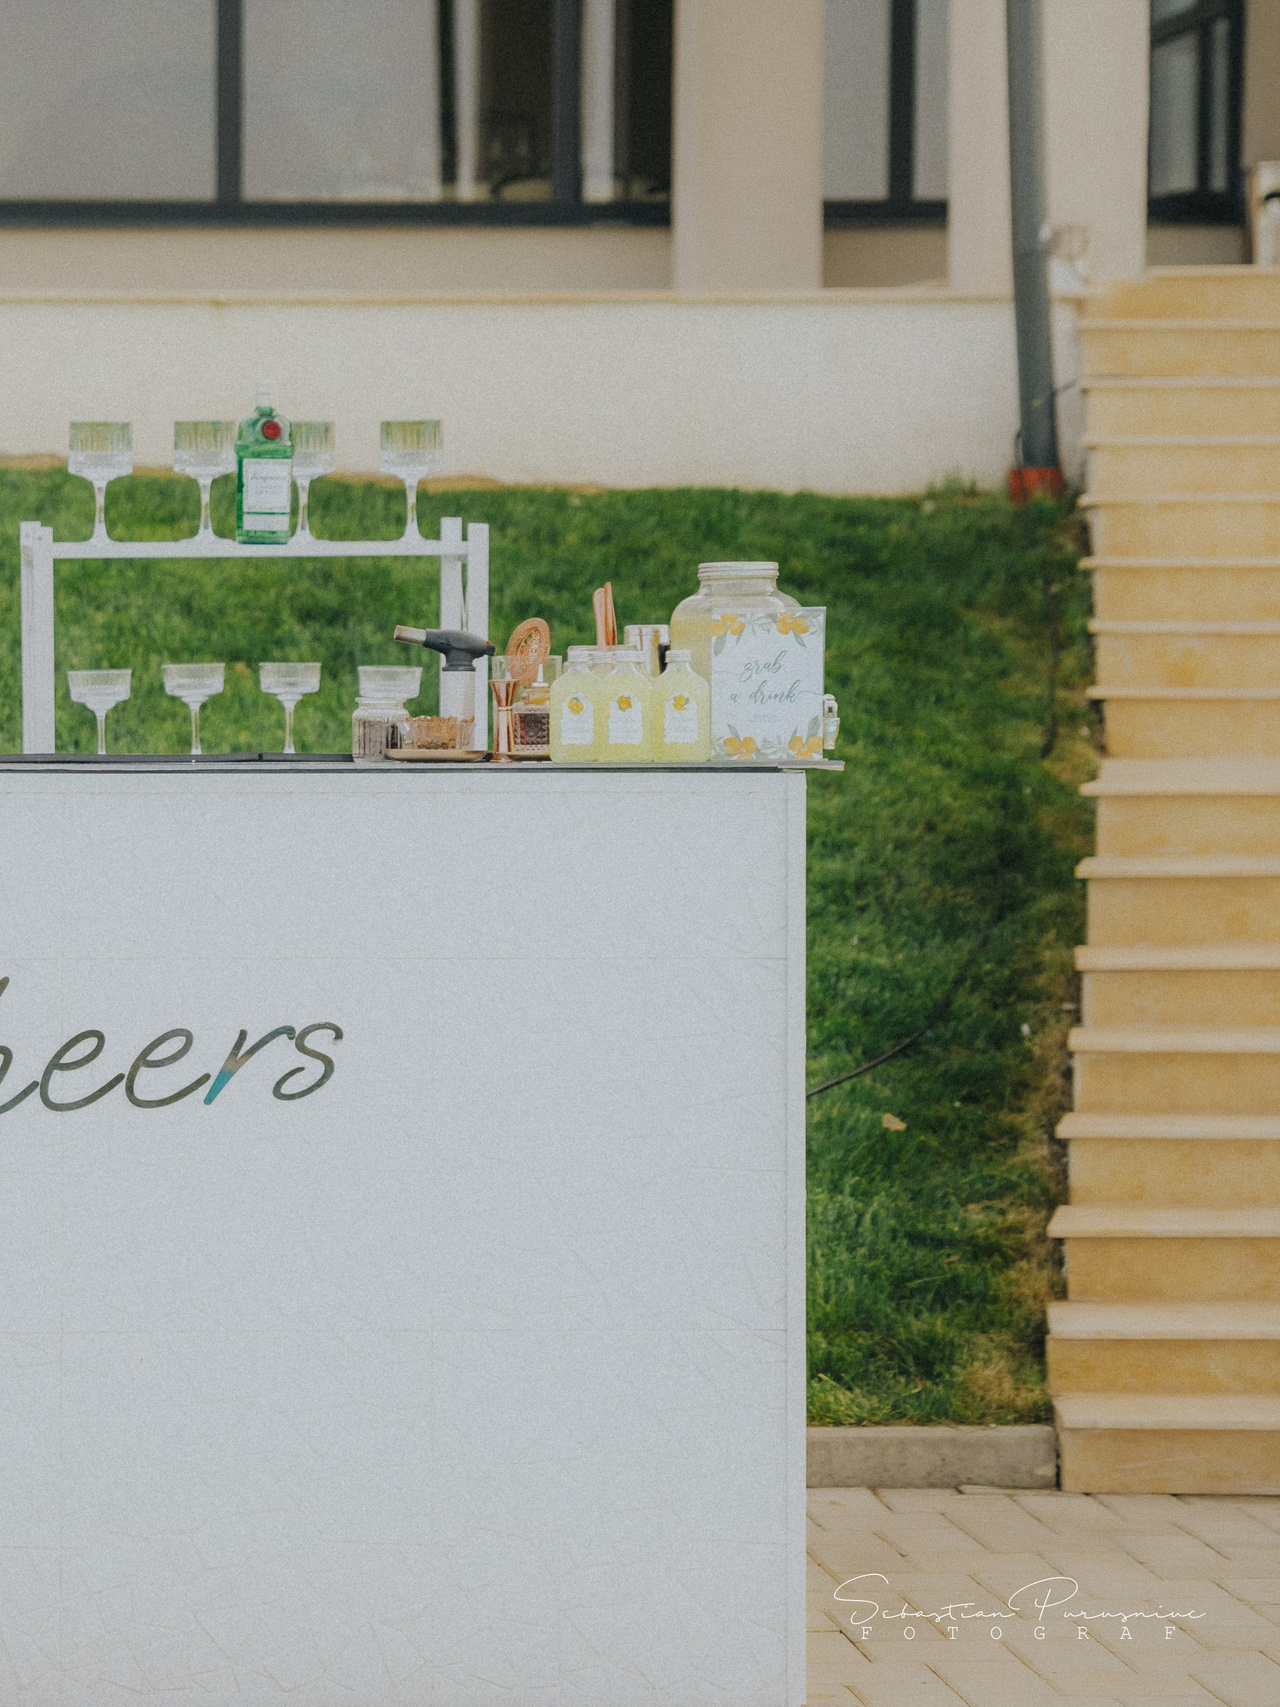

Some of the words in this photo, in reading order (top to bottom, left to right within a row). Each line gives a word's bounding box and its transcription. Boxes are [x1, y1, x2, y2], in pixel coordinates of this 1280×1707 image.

[738, 650, 787, 682] grab
[730, 693, 738, 703] a
[749, 680, 802, 704] drink
